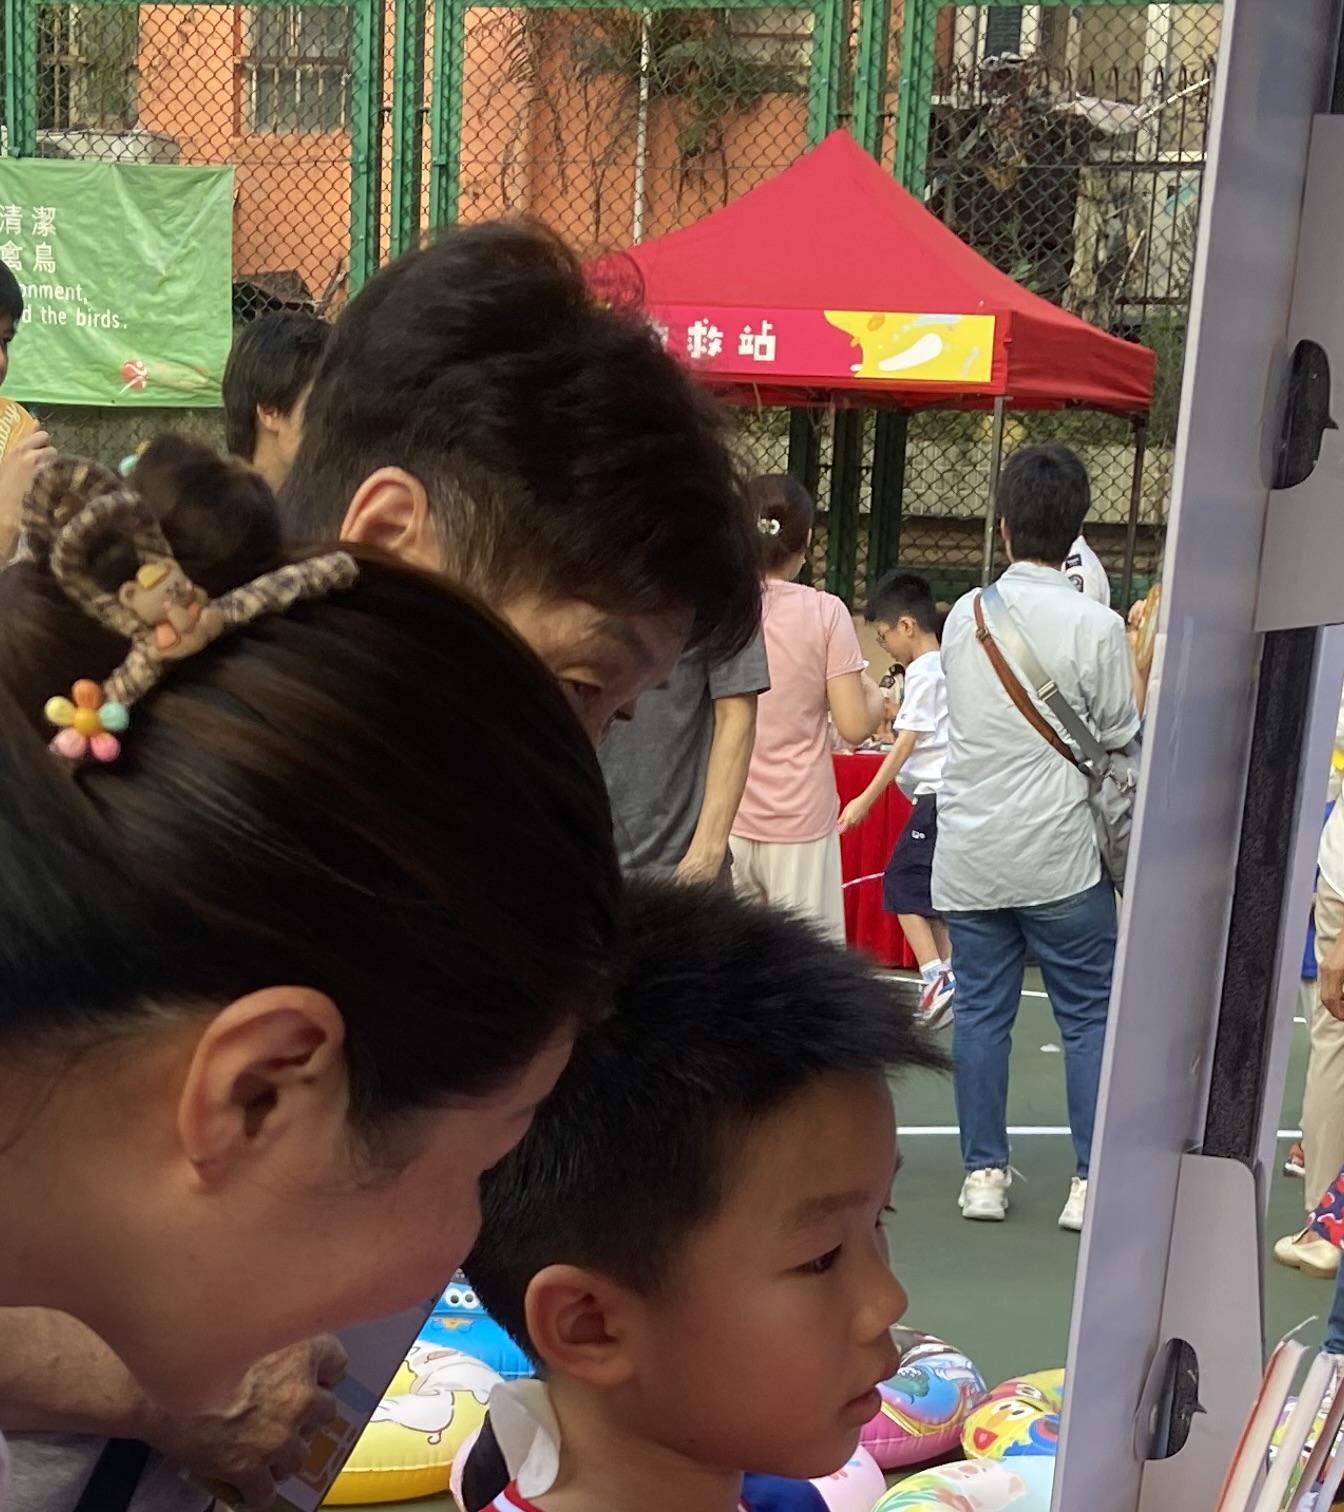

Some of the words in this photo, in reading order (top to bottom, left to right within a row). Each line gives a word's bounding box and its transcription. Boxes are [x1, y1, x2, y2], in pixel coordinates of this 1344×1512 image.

[41, 305, 67, 325] the
[77, 307, 127, 330] birds.
[648, 317, 776, 361] 救站
